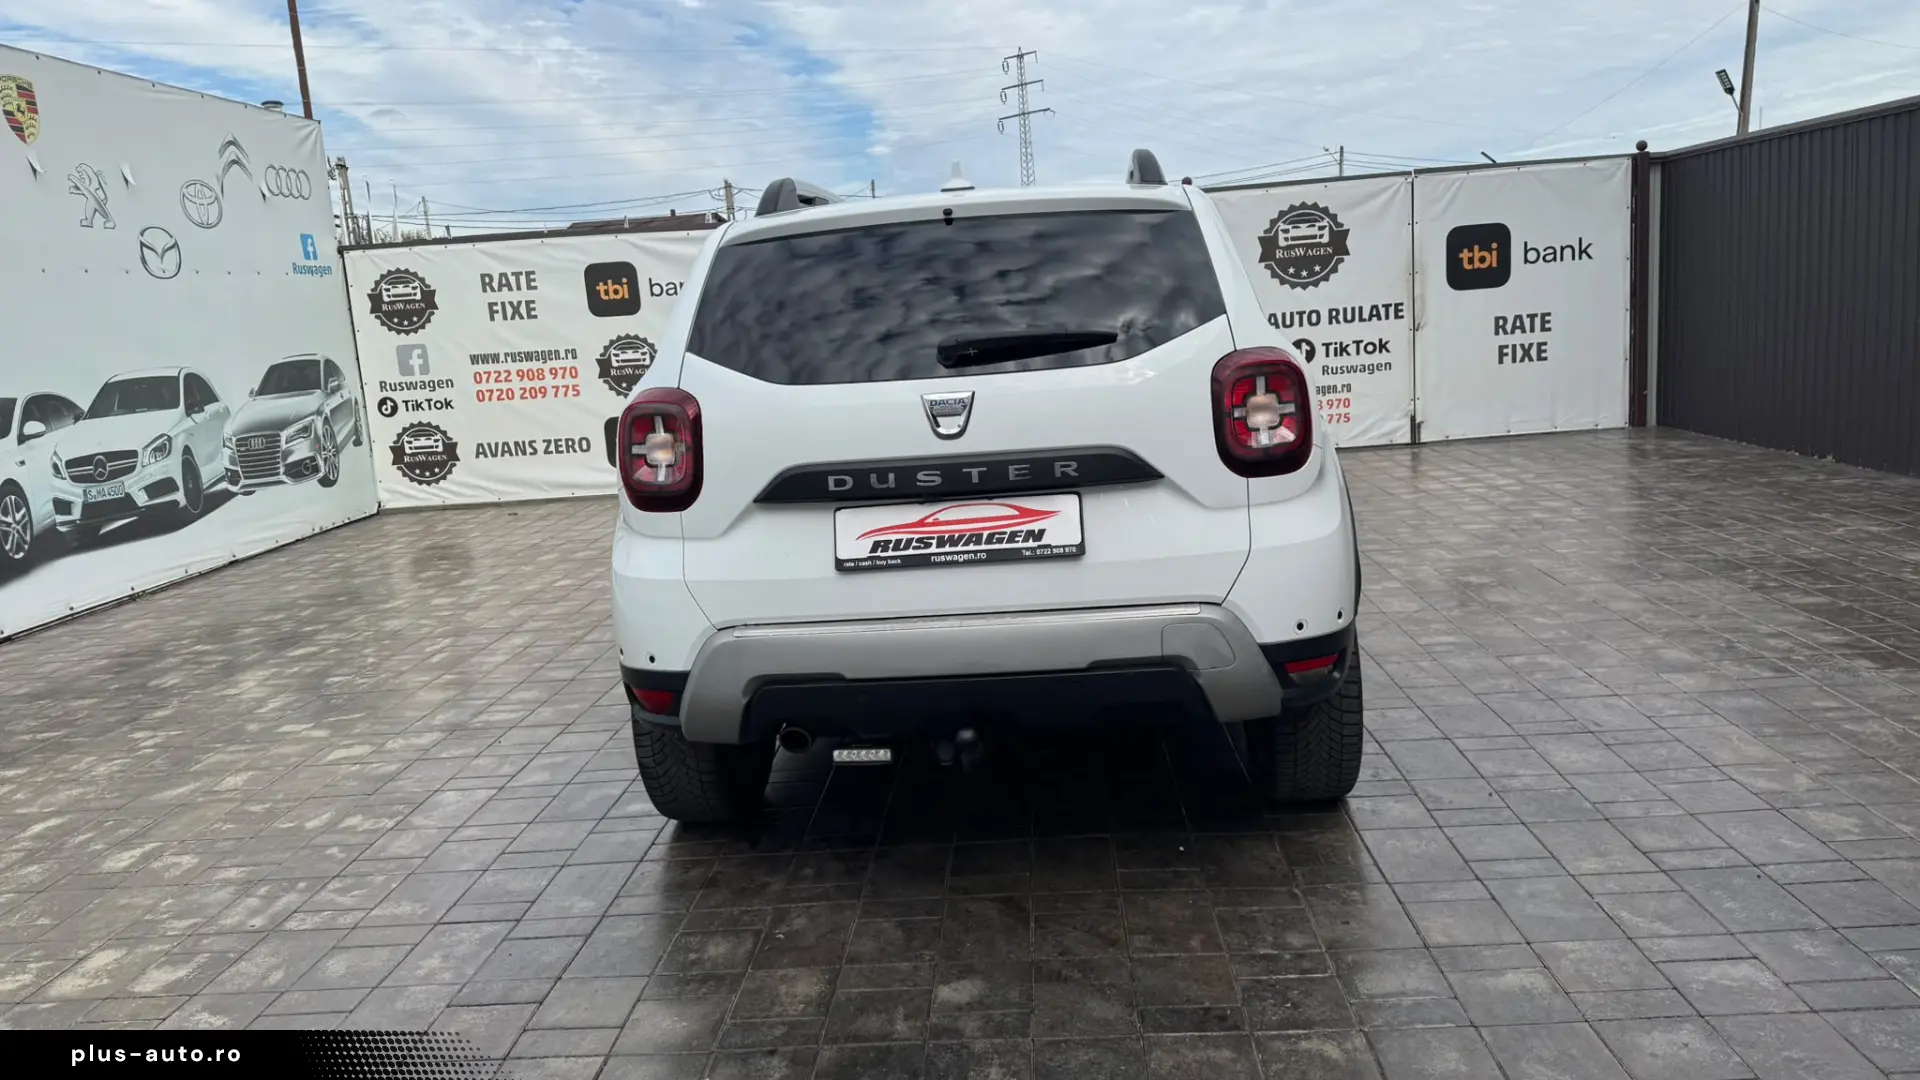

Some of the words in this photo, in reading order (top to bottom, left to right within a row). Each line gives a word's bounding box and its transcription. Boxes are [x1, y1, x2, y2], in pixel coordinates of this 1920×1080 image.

[1458, 242, 1498, 270] tbi
[1524, 237, 1594, 265] bank
[292, 262, 333, 278] Ruswagen
[480, 270, 538, 293] RATE
[596, 277, 630, 300] tbi
[649, 277, 684, 298] ba
[487, 300, 538, 322] FIXE
[1268, 309, 1321, 329] AUTO
[1328, 302, 1405, 325] RULATE
[1494, 312, 1553, 336] RATE
[469, 348, 578, 366] www.ruswagen.ro
[1322, 338, 1391, 358] TikTok
[1498, 341, 1549, 365] FIXE
[473, 370, 512, 384] 0722
[516, 368, 545, 382] 908
[549, 366, 578, 380] 970
[1322, 361, 1392, 376] Ruswagen
[379, 377, 455, 393] Ruswagen
[476, 387, 515, 402] 0720
[519, 386, 547, 399] 209
[551, 384, 581, 397] 775
[1315, 383, 1352, 397] agen.ro
[402, 398, 455, 413] TikTok
[929, 398, 966, 407] DACIA
[1326, 397, 1351, 410] 970
[1327, 412, 1351, 424] 775
[474, 440, 539, 459] AVANS
[542, 436, 592, 455] ZERO
[828, 460, 1080, 492] DUSTER
[868, 528, 1046, 555] RUSWAGEN
[931, 552, 986, 562] ruswagen.ro
